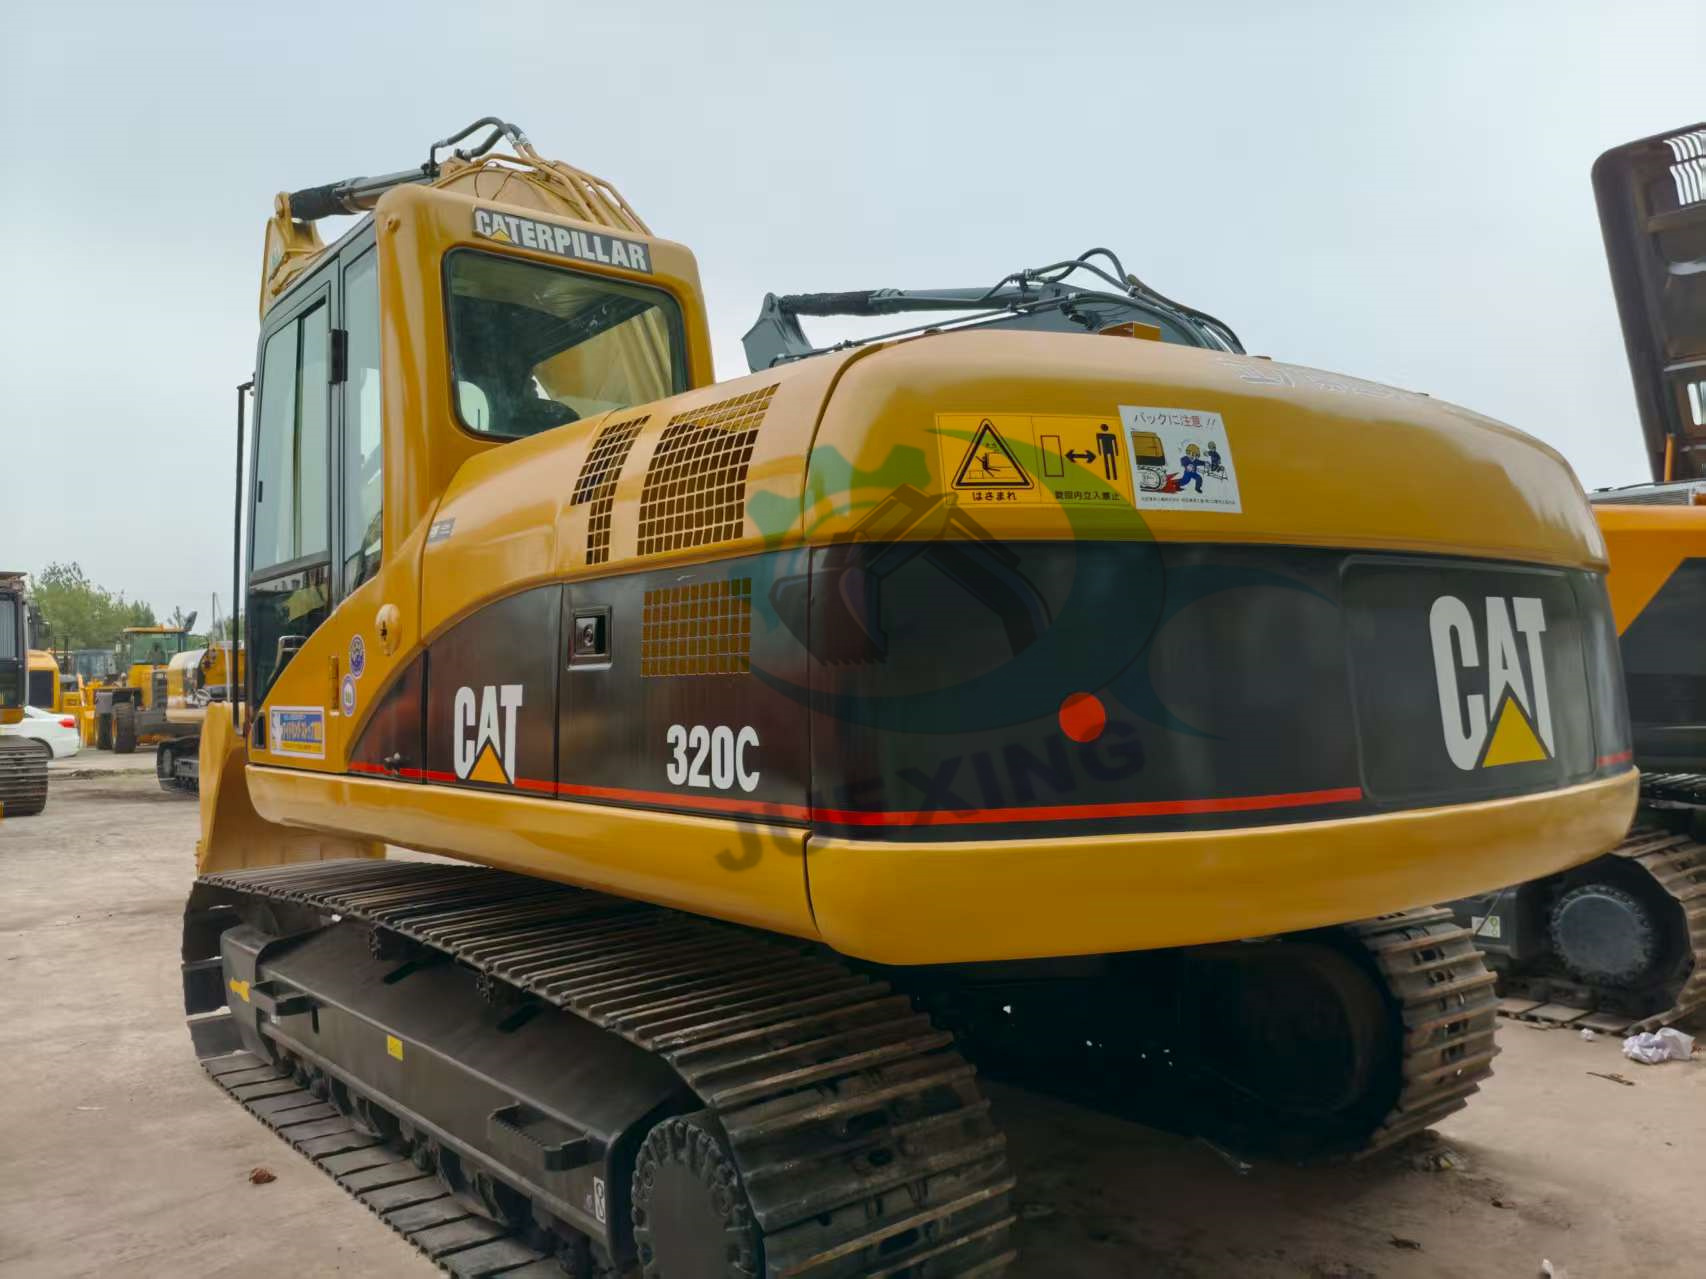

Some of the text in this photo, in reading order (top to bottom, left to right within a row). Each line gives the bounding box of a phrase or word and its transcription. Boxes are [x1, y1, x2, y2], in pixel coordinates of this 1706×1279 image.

[475, 209, 648, 272] CATERPILLAR
[1429, 595, 1556, 771] CAT
[453, 684, 524, 785] CAT
[666, 724, 760, 792] 320C
